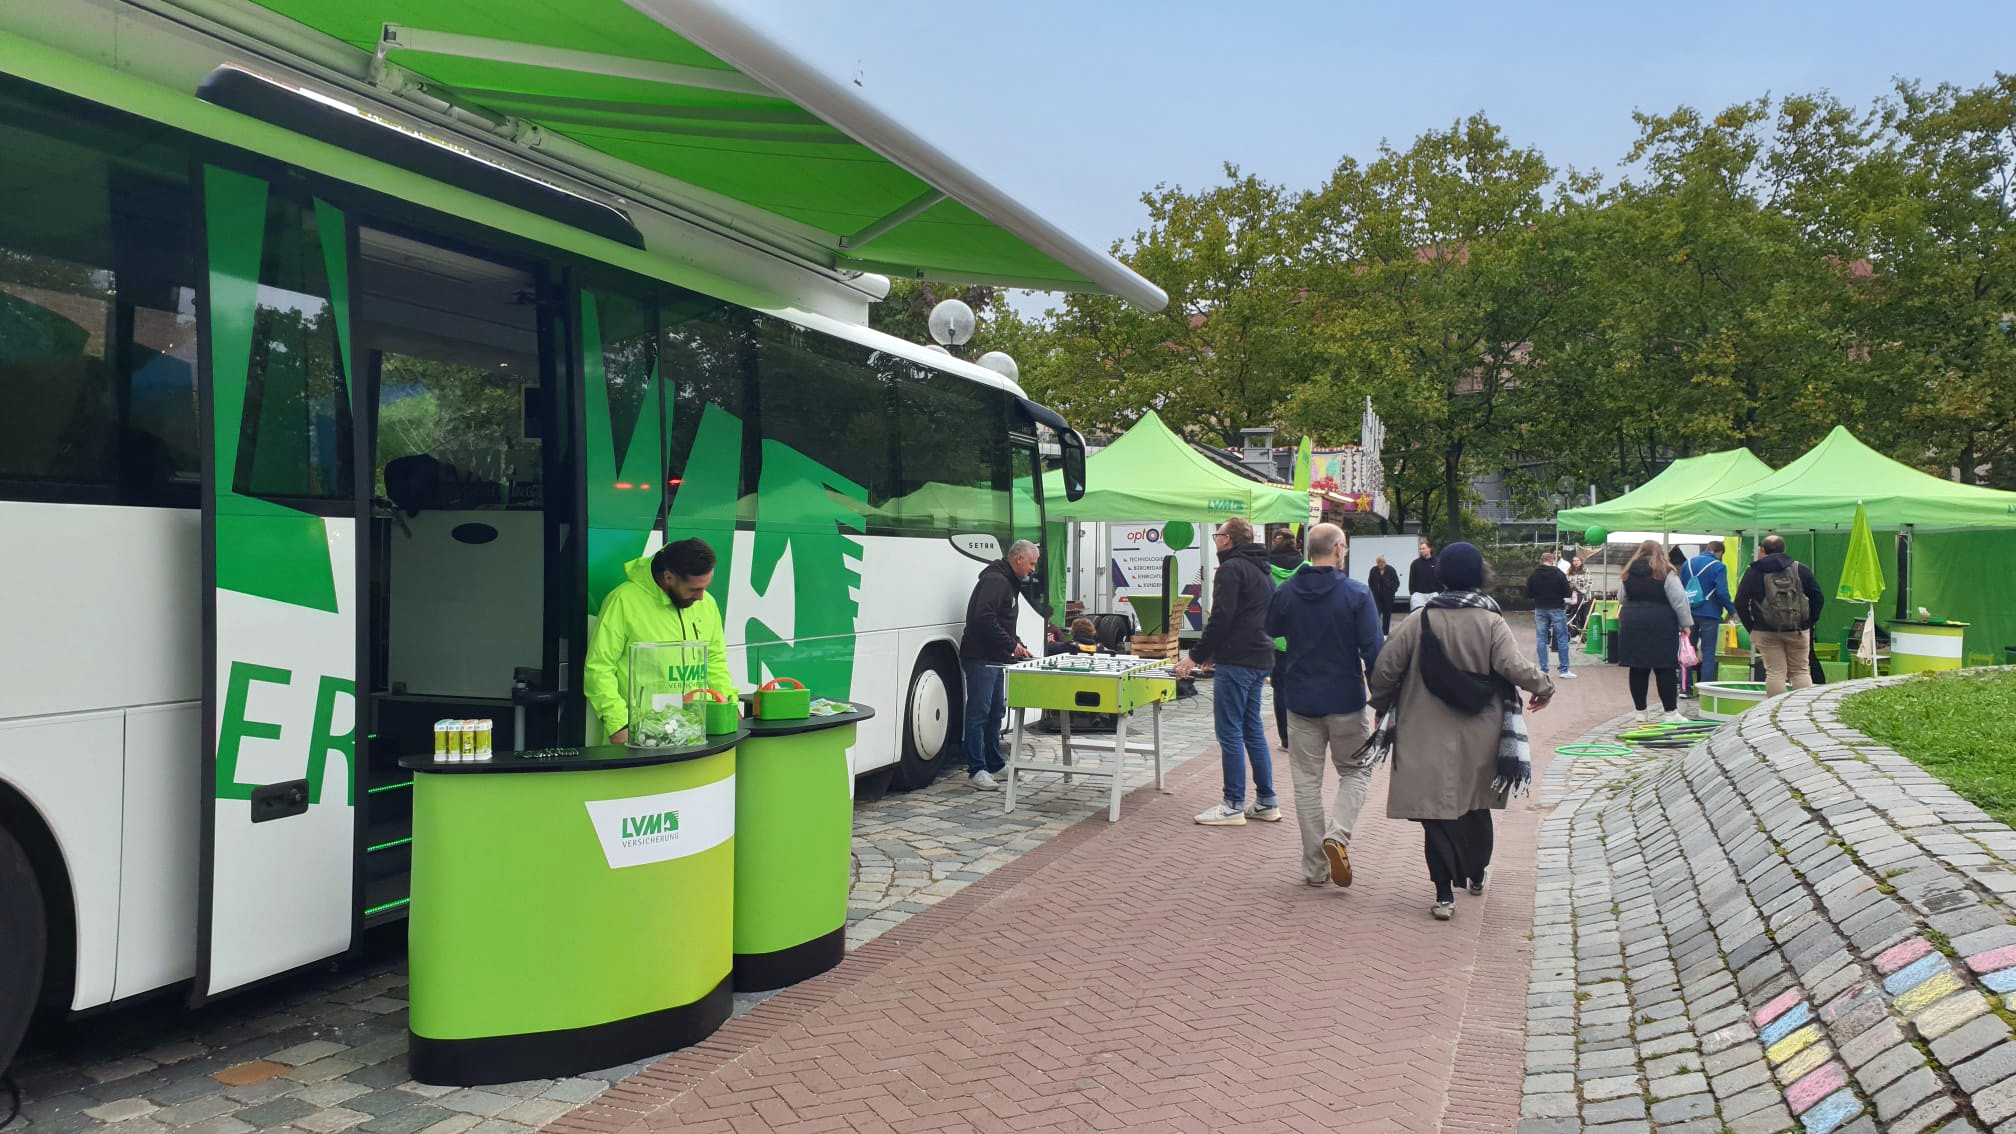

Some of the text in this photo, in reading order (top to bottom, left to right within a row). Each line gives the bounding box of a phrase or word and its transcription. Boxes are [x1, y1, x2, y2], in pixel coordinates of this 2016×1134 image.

[668, 664, 701, 682] LVM
[622, 813, 663, 838] LVM
[622, 832, 680, 848] VERSICHERUNG
